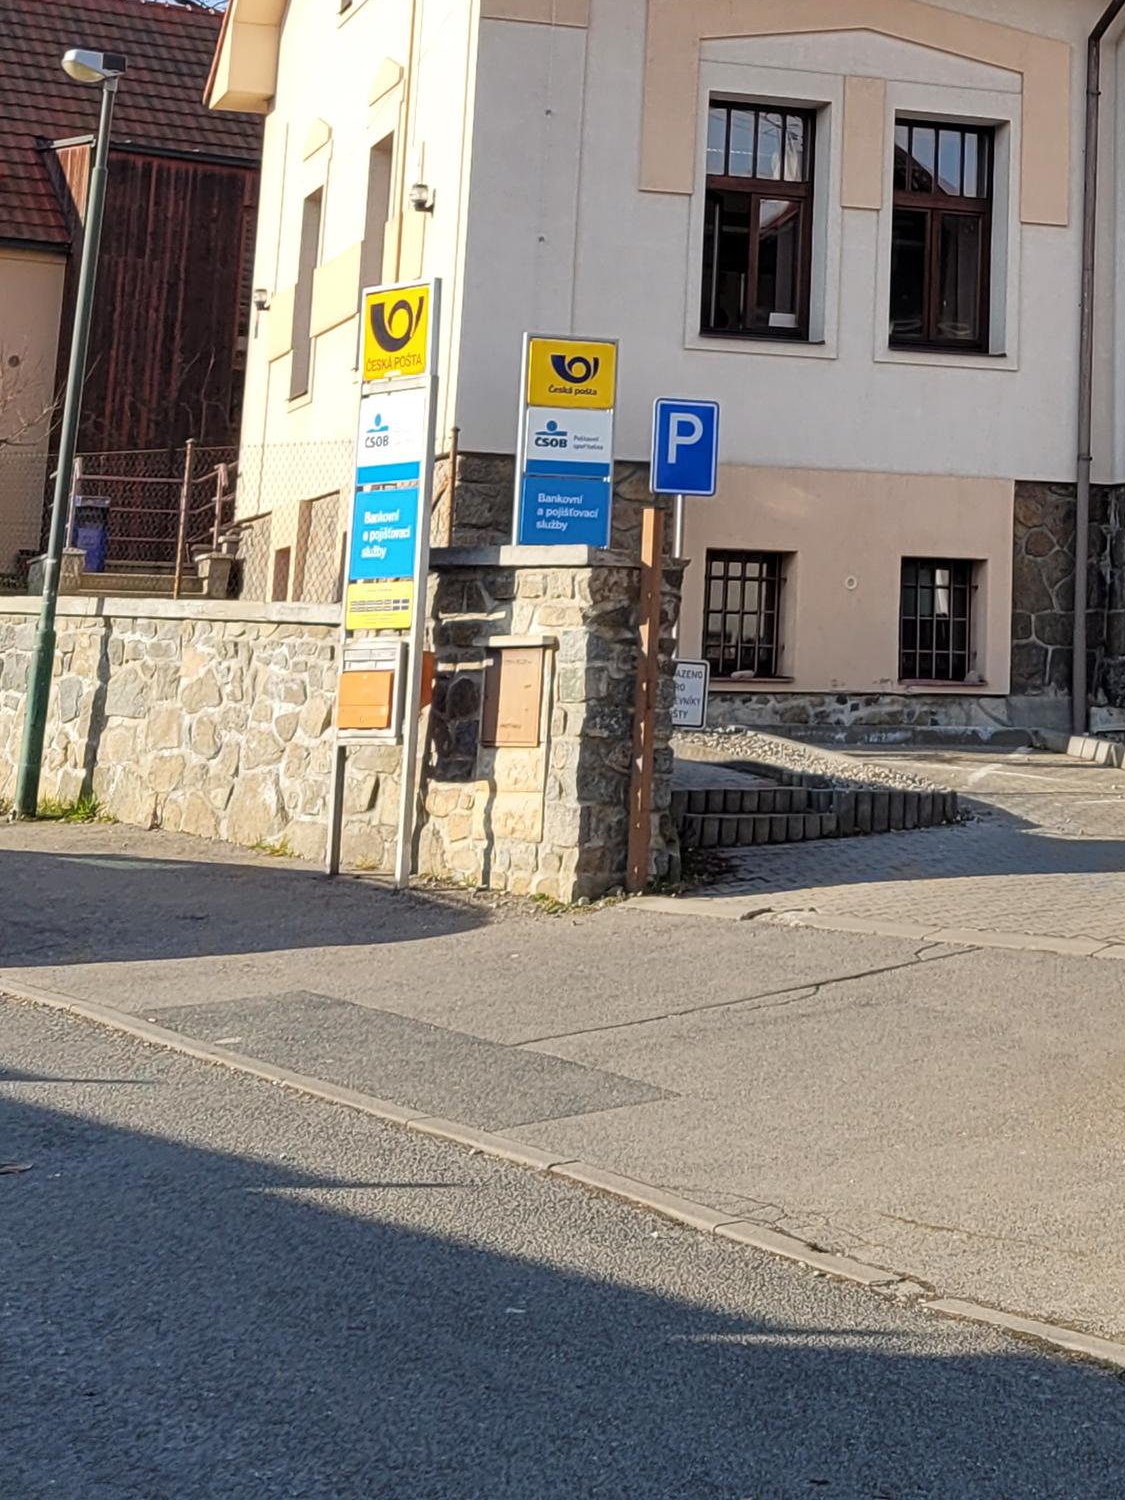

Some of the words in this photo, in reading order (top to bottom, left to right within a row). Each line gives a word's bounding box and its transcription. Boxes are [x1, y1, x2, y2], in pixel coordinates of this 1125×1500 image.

[366, 357, 392, 372] ČESKÁ
[394, 352, 423, 368] POŠTA
[548, 384, 573, 395] Česká
[574, 387, 598, 396] pošta
[667, 412, 704, 464] P
[538, 493, 583, 504] Bankovní
[364, 509, 400, 524] Bankovní
[546, 508, 599, 519] pojišťovací
[536, 519, 568, 532] služby
[362, 532, 368, 542] a
[361, 546, 387, 560] služby
[676, 669, 703, 679] AZENO
